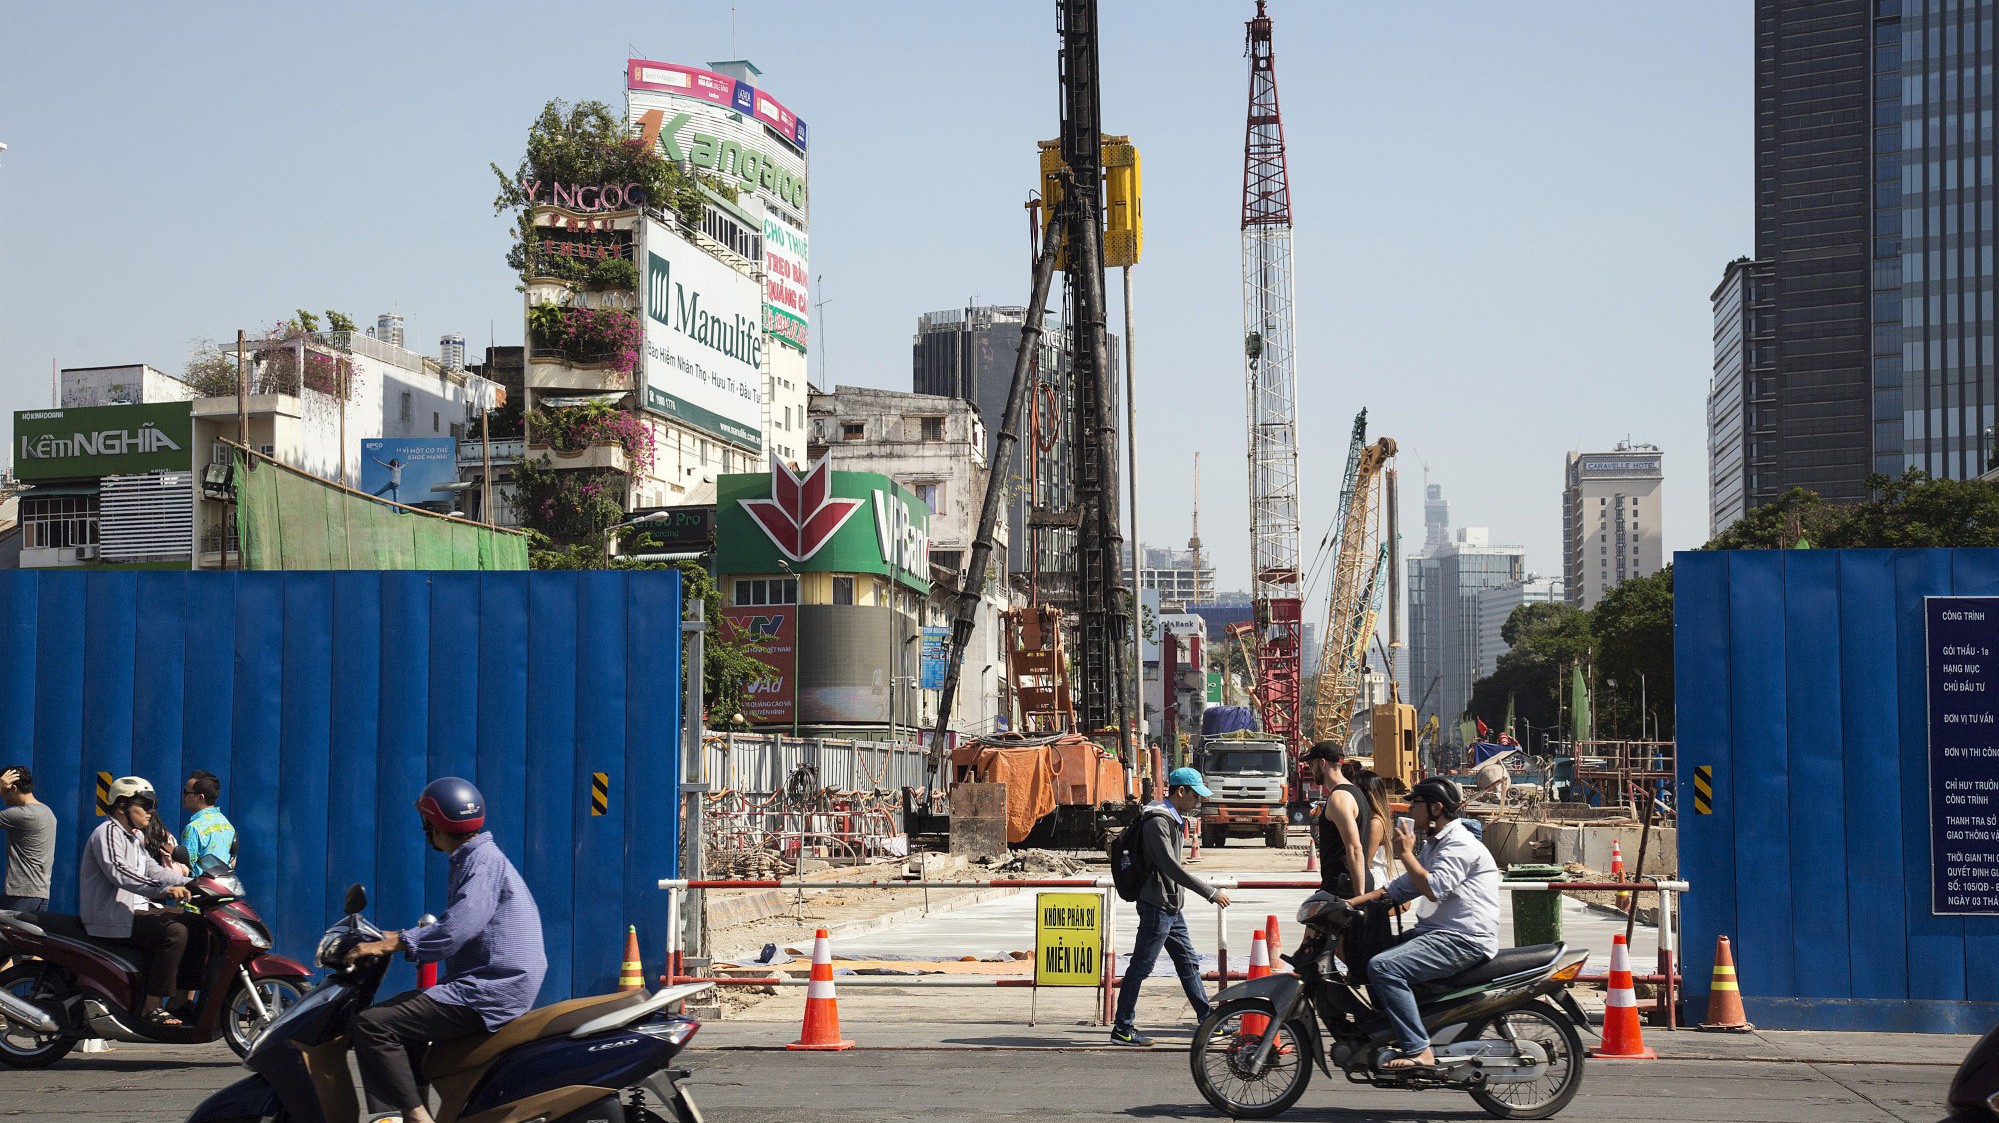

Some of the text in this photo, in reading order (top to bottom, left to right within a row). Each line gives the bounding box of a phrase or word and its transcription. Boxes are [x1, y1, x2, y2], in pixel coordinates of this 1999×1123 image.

[634, 109, 805, 209] Kangaroo
[764, 218, 785, 248] CHO
[766, 250, 791, 280] TREO
[768, 277, 797, 310] QUẢNG
[674, 281, 762, 370] Manulife
[660, 346, 676, 368] Hiểm
[678, 355, 694, 376] Nhân
[695, 363, 707, 385] Thọ
[31, 412, 44, 420] KINH
[676, 512, 700, 526] Pro
[872, 489, 930, 584] VPBank
[1942, 610, 1985, 621] CÔNG TRÌNH
[1981, 647, 1988, 656] 1a
[1943, 664, 1980, 675] HẠNG MỤC
[1976, 682, 1985, 691] TƯ
[1944, 714, 1958, 723] ĐƠN
[1960, 714, 1968, 725] VỊ
[1969, 714, 1978, 723] TƯ
[1945, 748, 1959, 757] ĐƠN
[1961, 748, 1968, 758] VỊ
[1969, 748, 1980, 757] THI
[1959, 782, 1973, 790] HUY
[1946, 794, 1988, 804] CÔNG TRÌNH
[1946, 814, 1997, 825] THANH TRA SỞ
[1947, 831, 1963, 840] GIAO
[1965, 829, 1989, 840] THÔNG
[1964, 854, 1982, 862] GIAN
[1983, 854, 1994, 862] THI
[1948, 865, 1970, 876] QUYẾT
[1972, 868, 1989, 878] ĐỊNH
[1948, 879, 1961, 891] SỐ:
[1963, 882, 1989, 891] 105/QĐ
[1948, 895, 1970, 905] NGÀY
[1972, 897, 1981, 905] 03
[1044, 904, 1066, 926] KHÔNG
[1046, 936, 1093, 974] MIỄN VÀO
